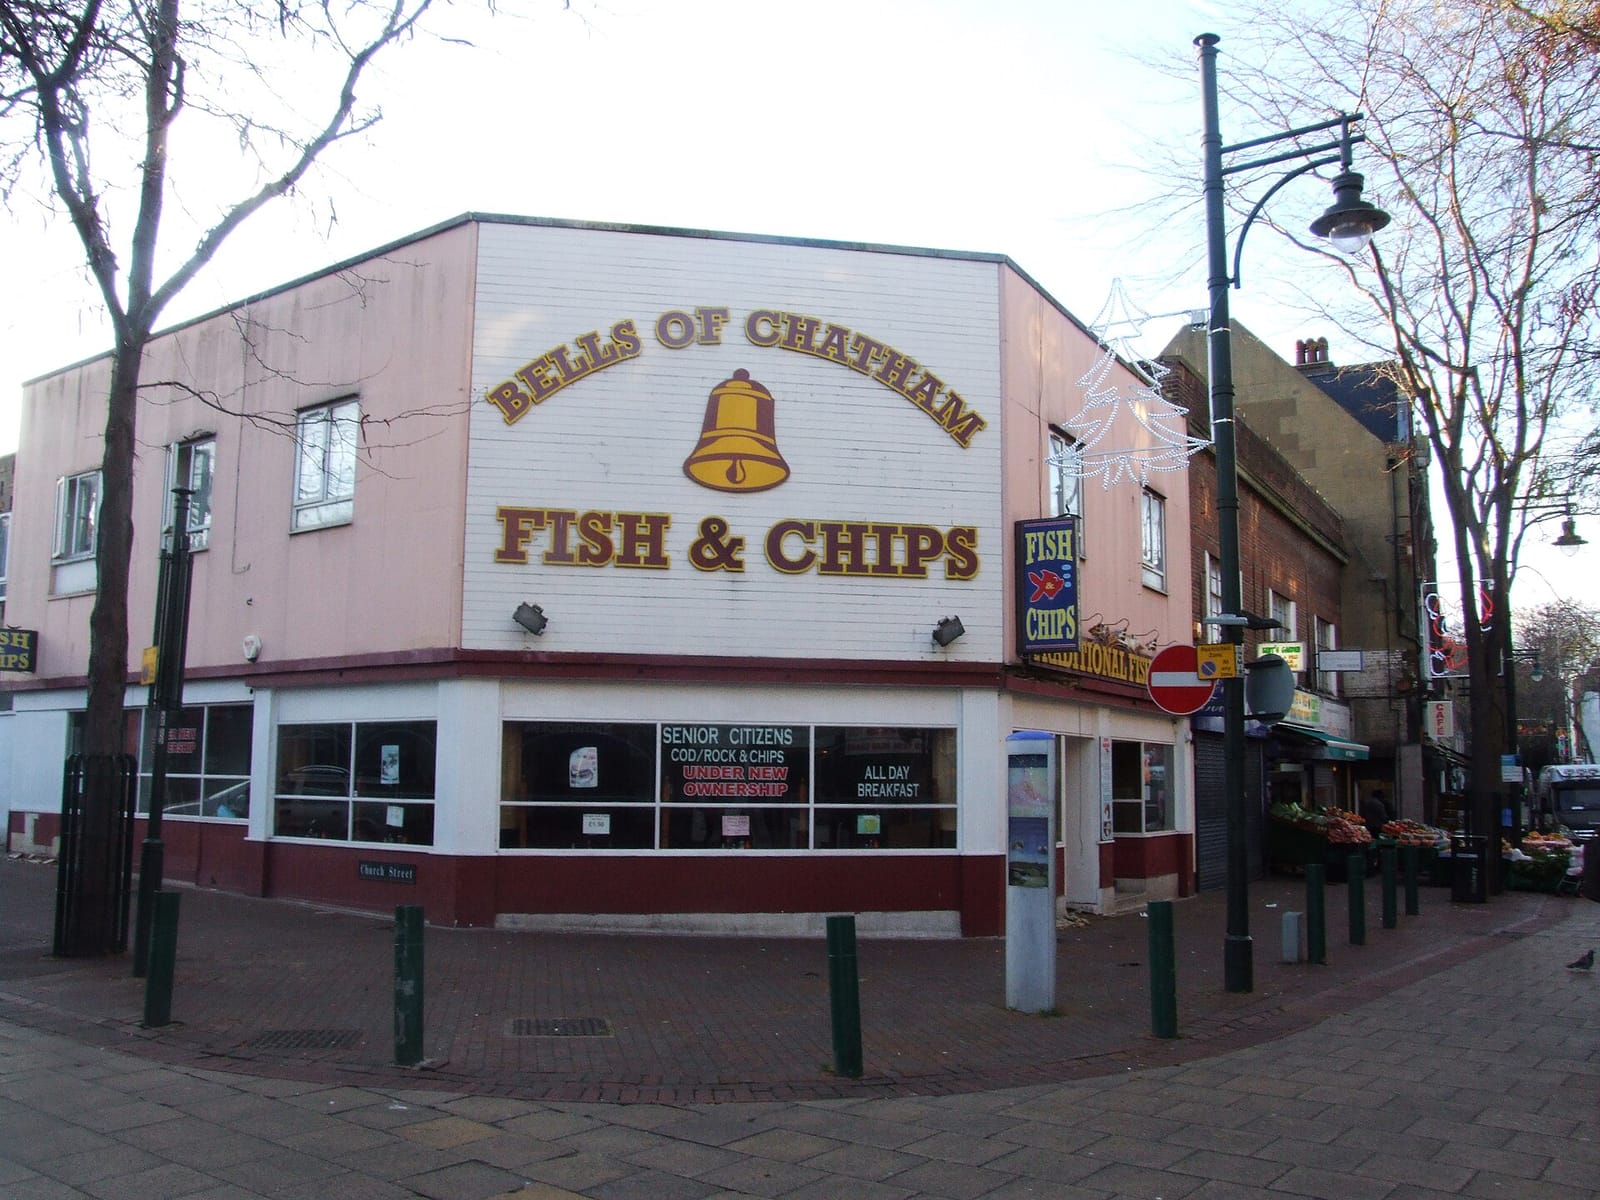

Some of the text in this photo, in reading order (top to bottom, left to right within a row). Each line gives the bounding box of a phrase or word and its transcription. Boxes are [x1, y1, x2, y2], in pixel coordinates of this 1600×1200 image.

[485, 306, 987, 449] BELLS OF CHATHAM
[495, 505, 981, 580] FISH & CHIPS
[1025, 529, 1073, 565] FISH
[1025, 605, 1076, 641] CHIPS
[662, 726, 793, 745] SENIOR CITIZENS
[671, 748, 784, 763] COD/ROCK & CHIPS
[683, 765, 789, 781] UNDER NEW
[864, 766, 910, 780] ALL DAY
[683, 782, 789, 797] OWNERSHIP
[857, 783, 920, 798] BREAKFAST
[360, 863, 413, 879] Church Street
